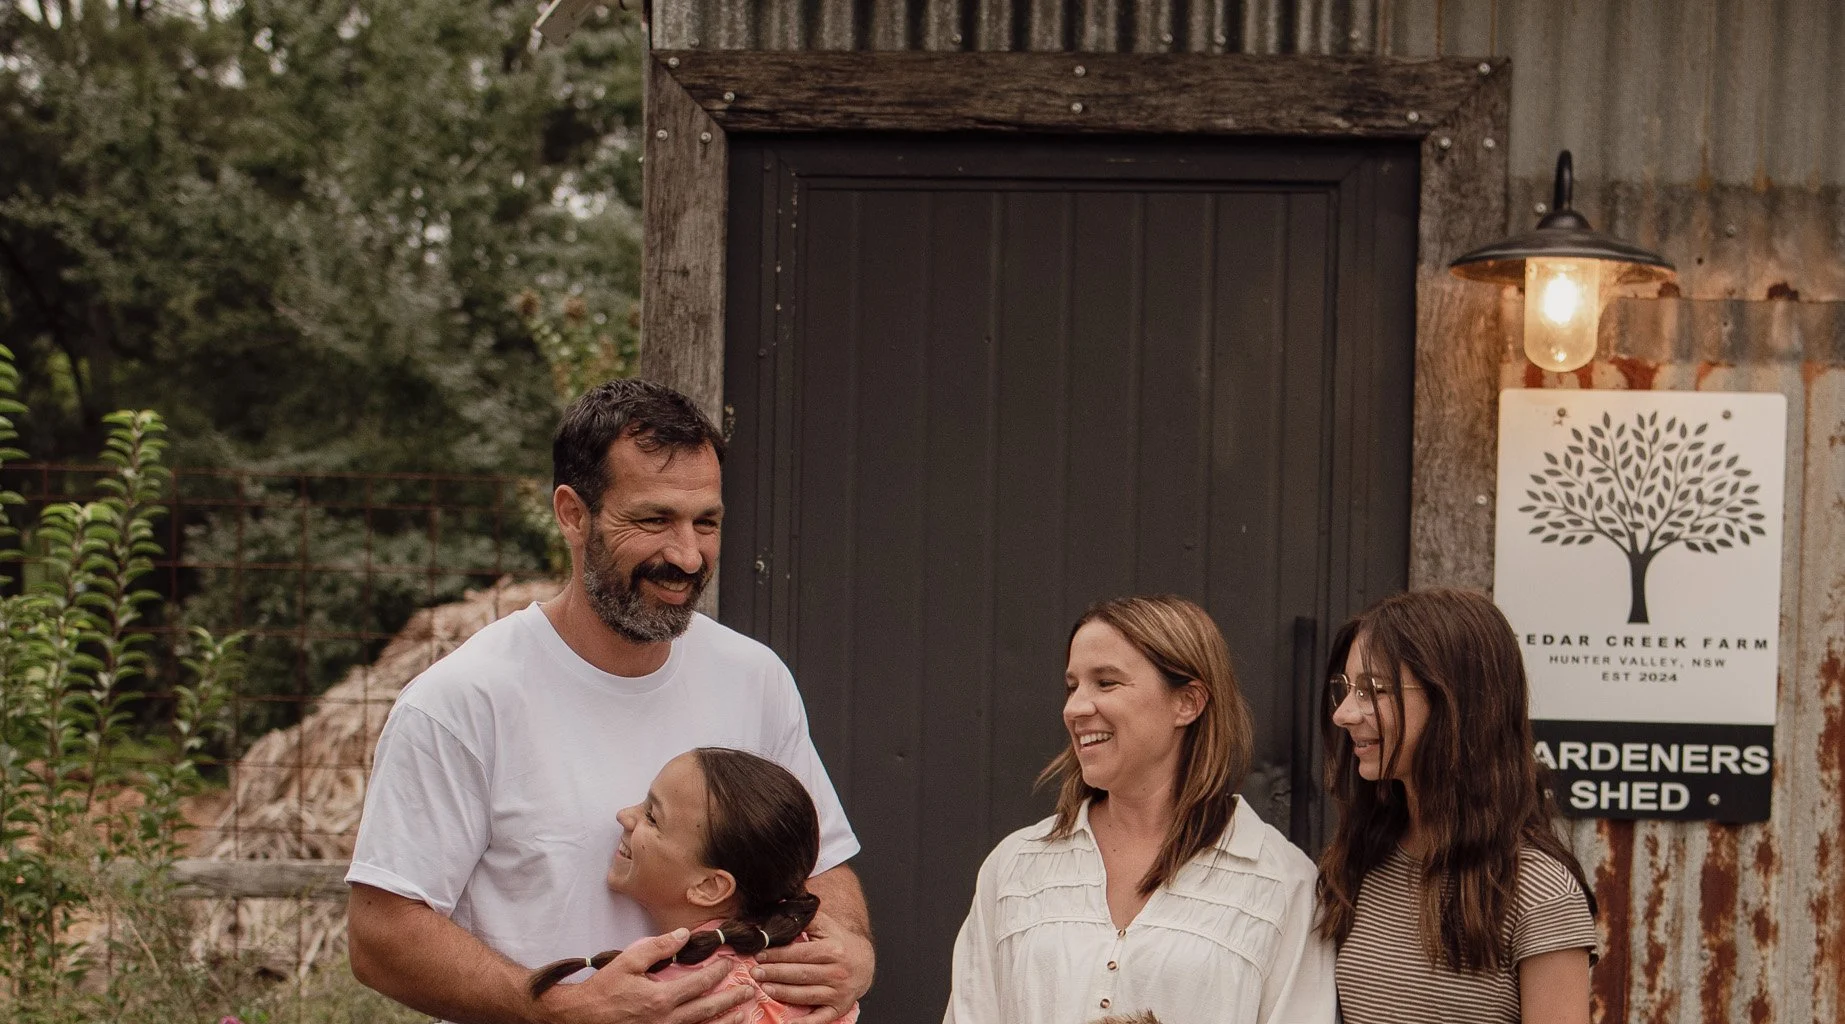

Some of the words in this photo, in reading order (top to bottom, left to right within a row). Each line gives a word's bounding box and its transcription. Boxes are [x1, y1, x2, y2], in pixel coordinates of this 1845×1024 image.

[1514, 632, 1590, 646] EDAR
[1606, 635, 1687, 649] CREEK
[1703, 638, 1768, 650] FARM
[1549, 655, 1611, 665] HUNTER
[1619, 656, 1684, 668] VALLEY,
[1692, 658, 1726, 668] NSW
[1601, 672, 1631, 681] EST
[1639, 673, 1678, 682] 2024
[1533, 741, 1770, 774] ARDENERS
[1569, 780, 1690, 811] SHED
